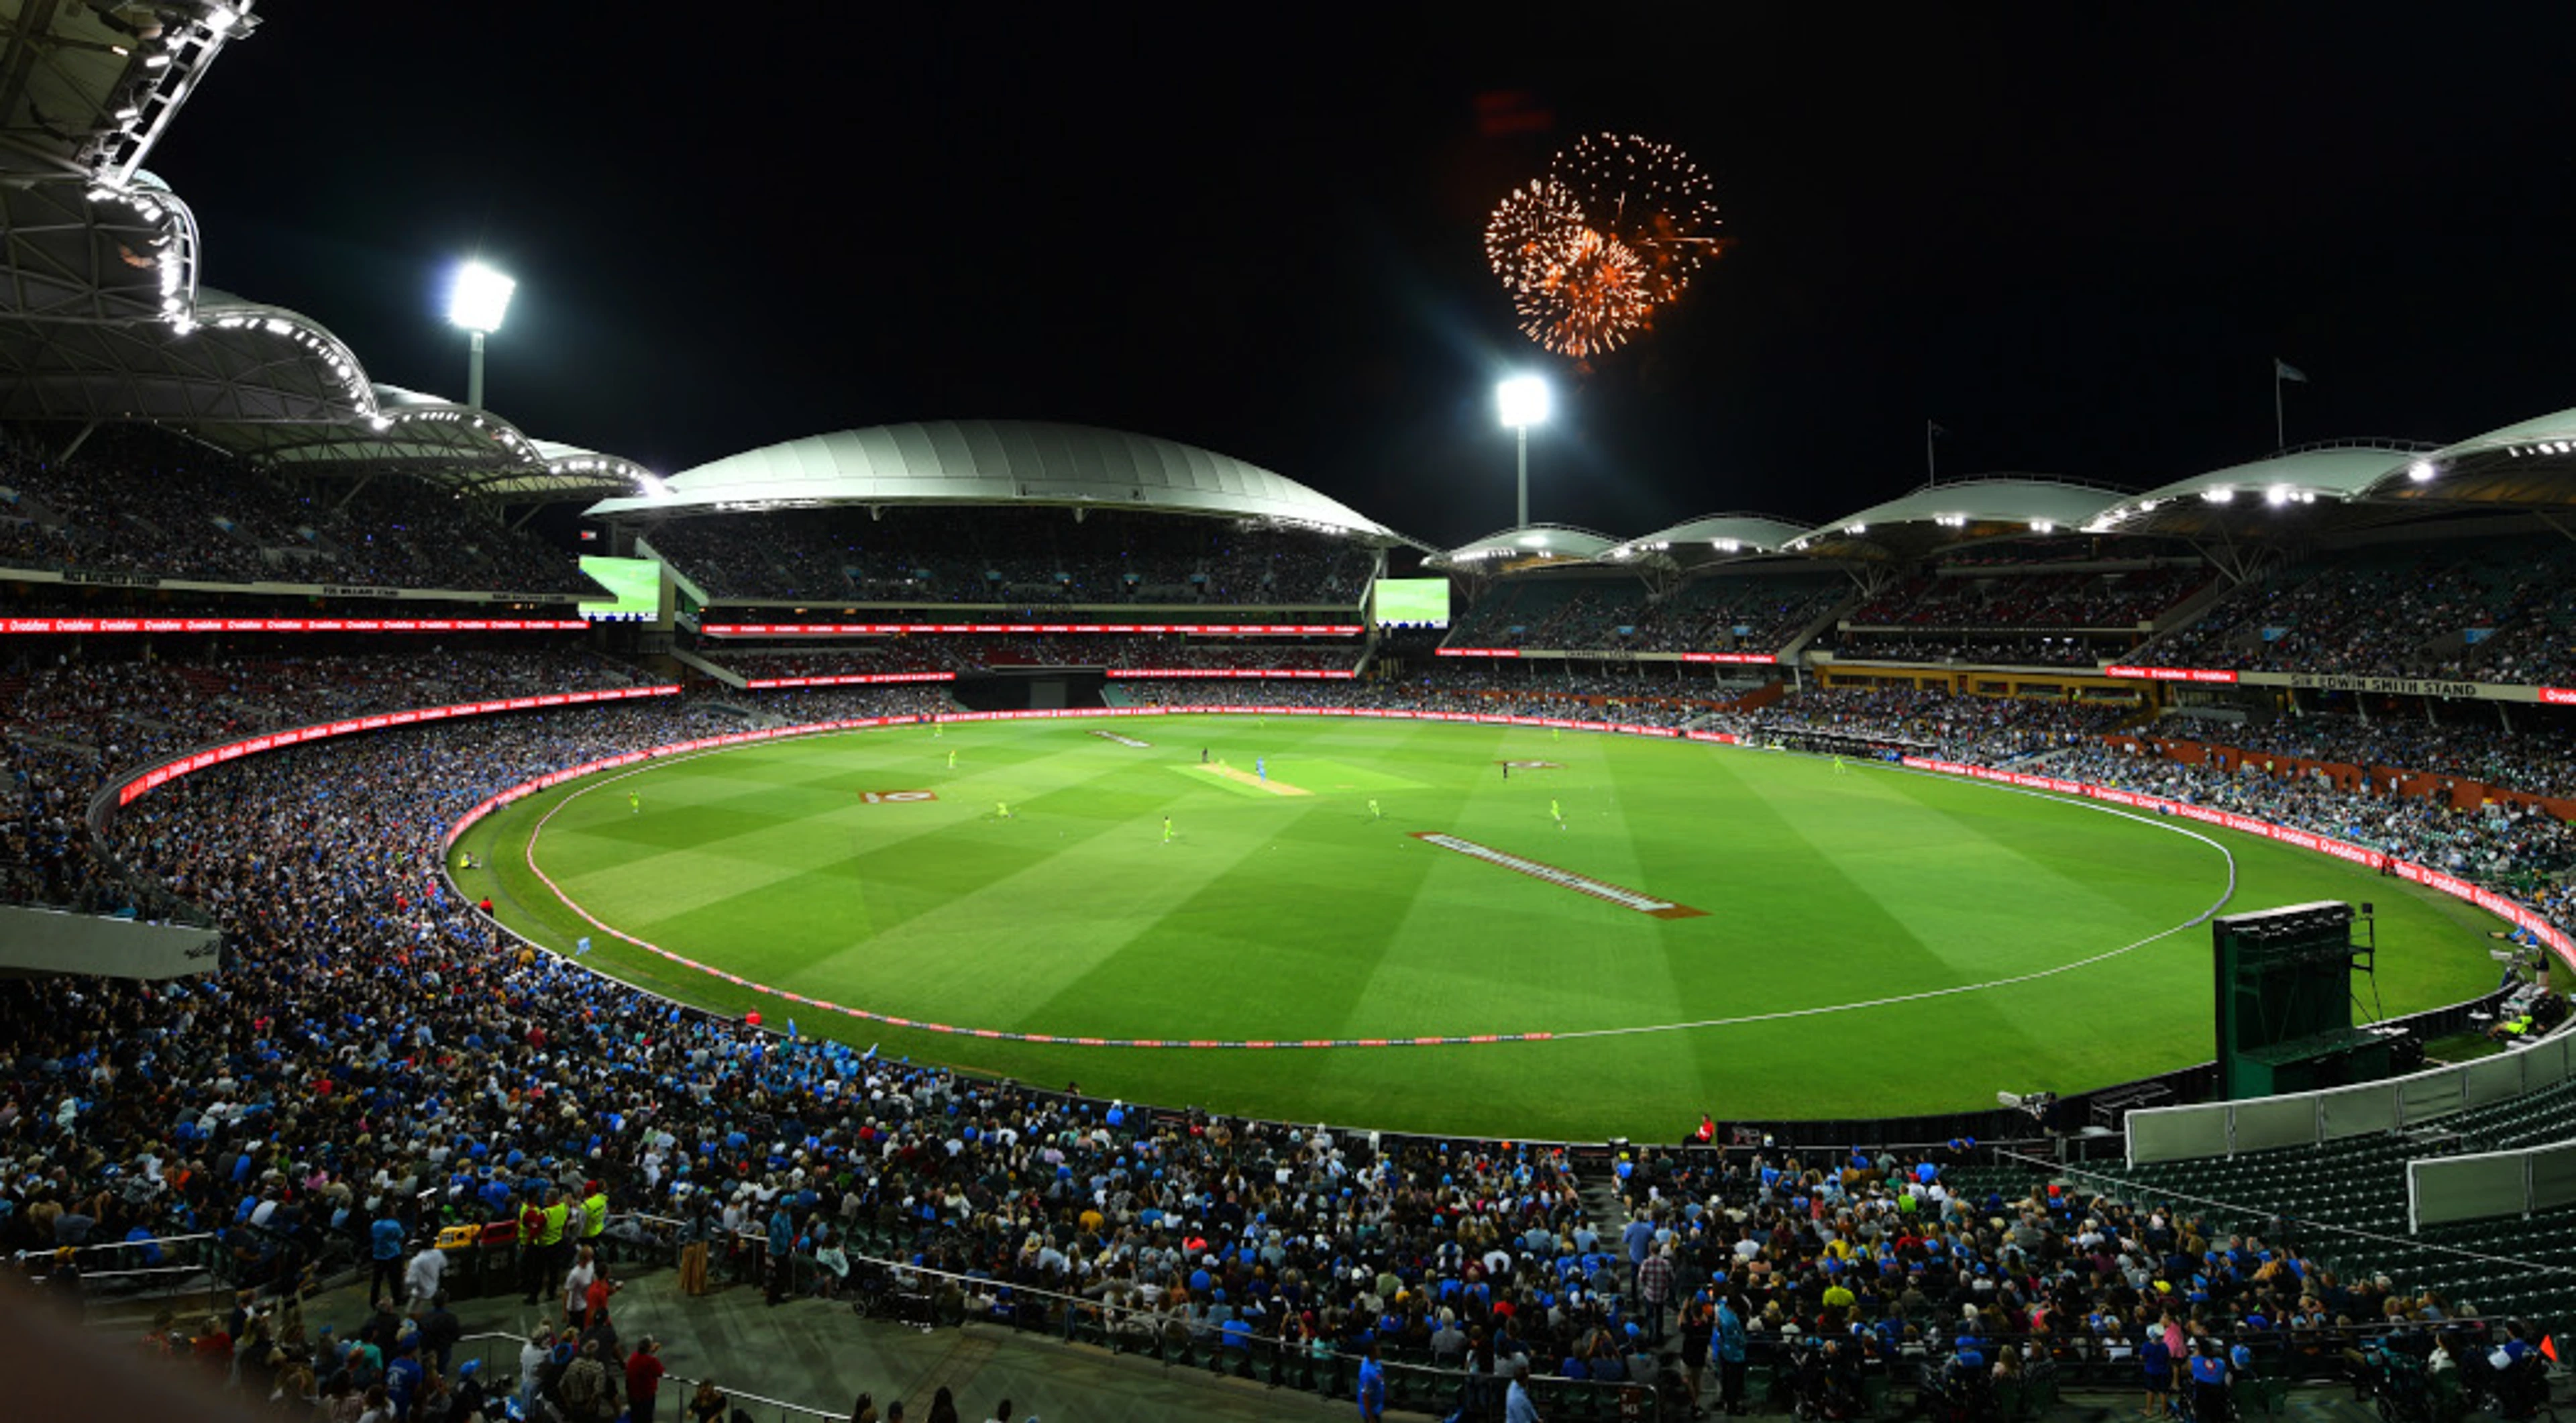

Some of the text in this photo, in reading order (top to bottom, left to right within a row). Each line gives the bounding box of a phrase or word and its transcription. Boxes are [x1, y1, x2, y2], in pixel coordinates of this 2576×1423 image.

[2319, 676, 2366, 690] EDWIN
[2372, 679, 2418, 692] SMITH
[2424, 682, 2477, 696] STAND
[2281, 830, 2316, 849] vodafone
[2330, 844, 2365, 863] vodafone
[2434, 876, 2471, 900] vodafone
